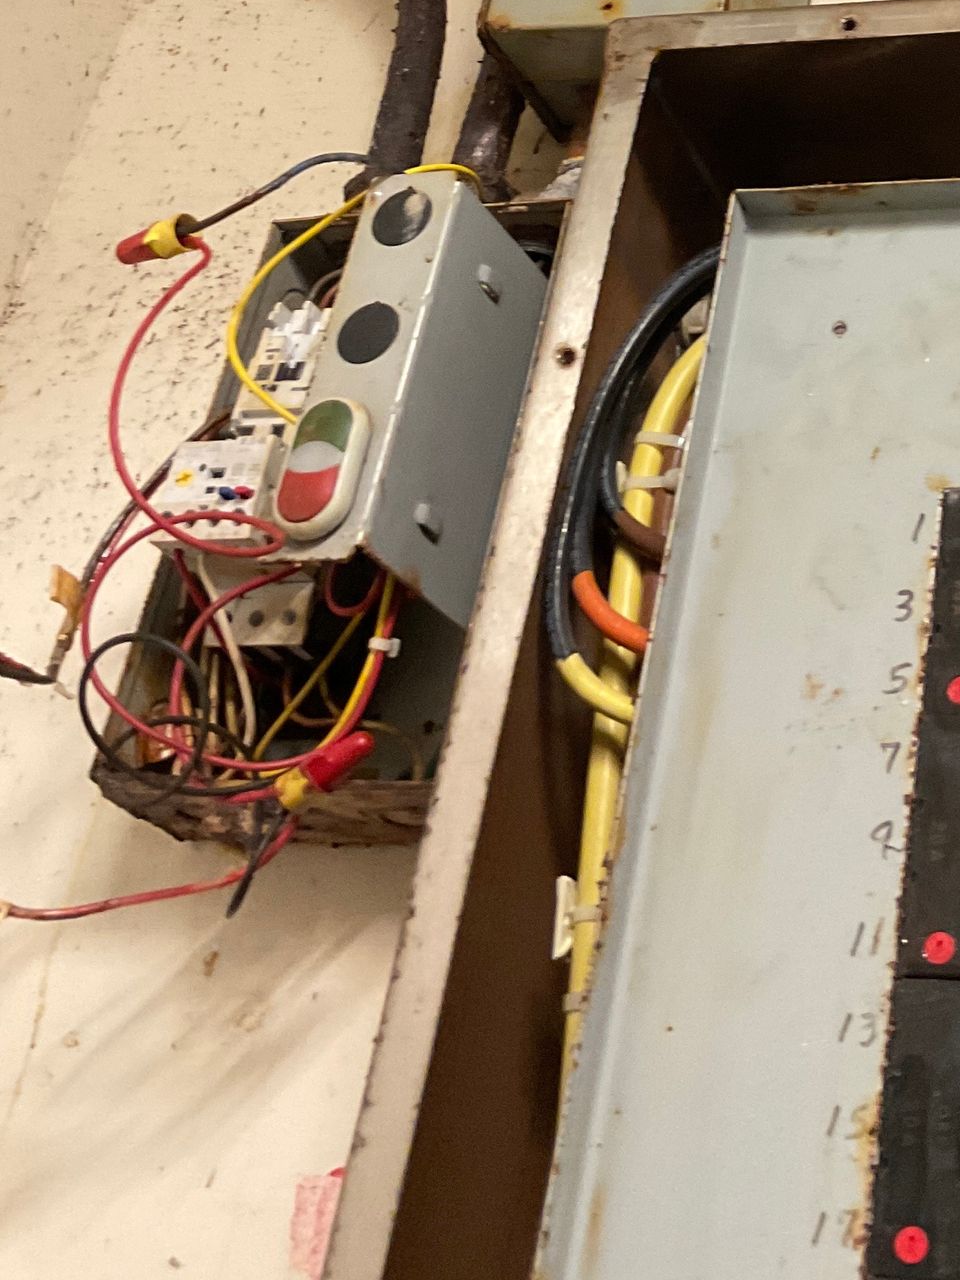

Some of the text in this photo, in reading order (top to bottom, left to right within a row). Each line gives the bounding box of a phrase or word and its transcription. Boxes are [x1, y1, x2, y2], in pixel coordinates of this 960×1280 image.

[911, 513, 926, 542] 1
[893, 589, 914, 622] 3
[882, 662, 913, 695] 5
[879, 742, 901, 774] 7
[870, 820, 894, 860] 9
[850, 917, 886, 957] 11
[838, 1013, 878, 1048] 13
